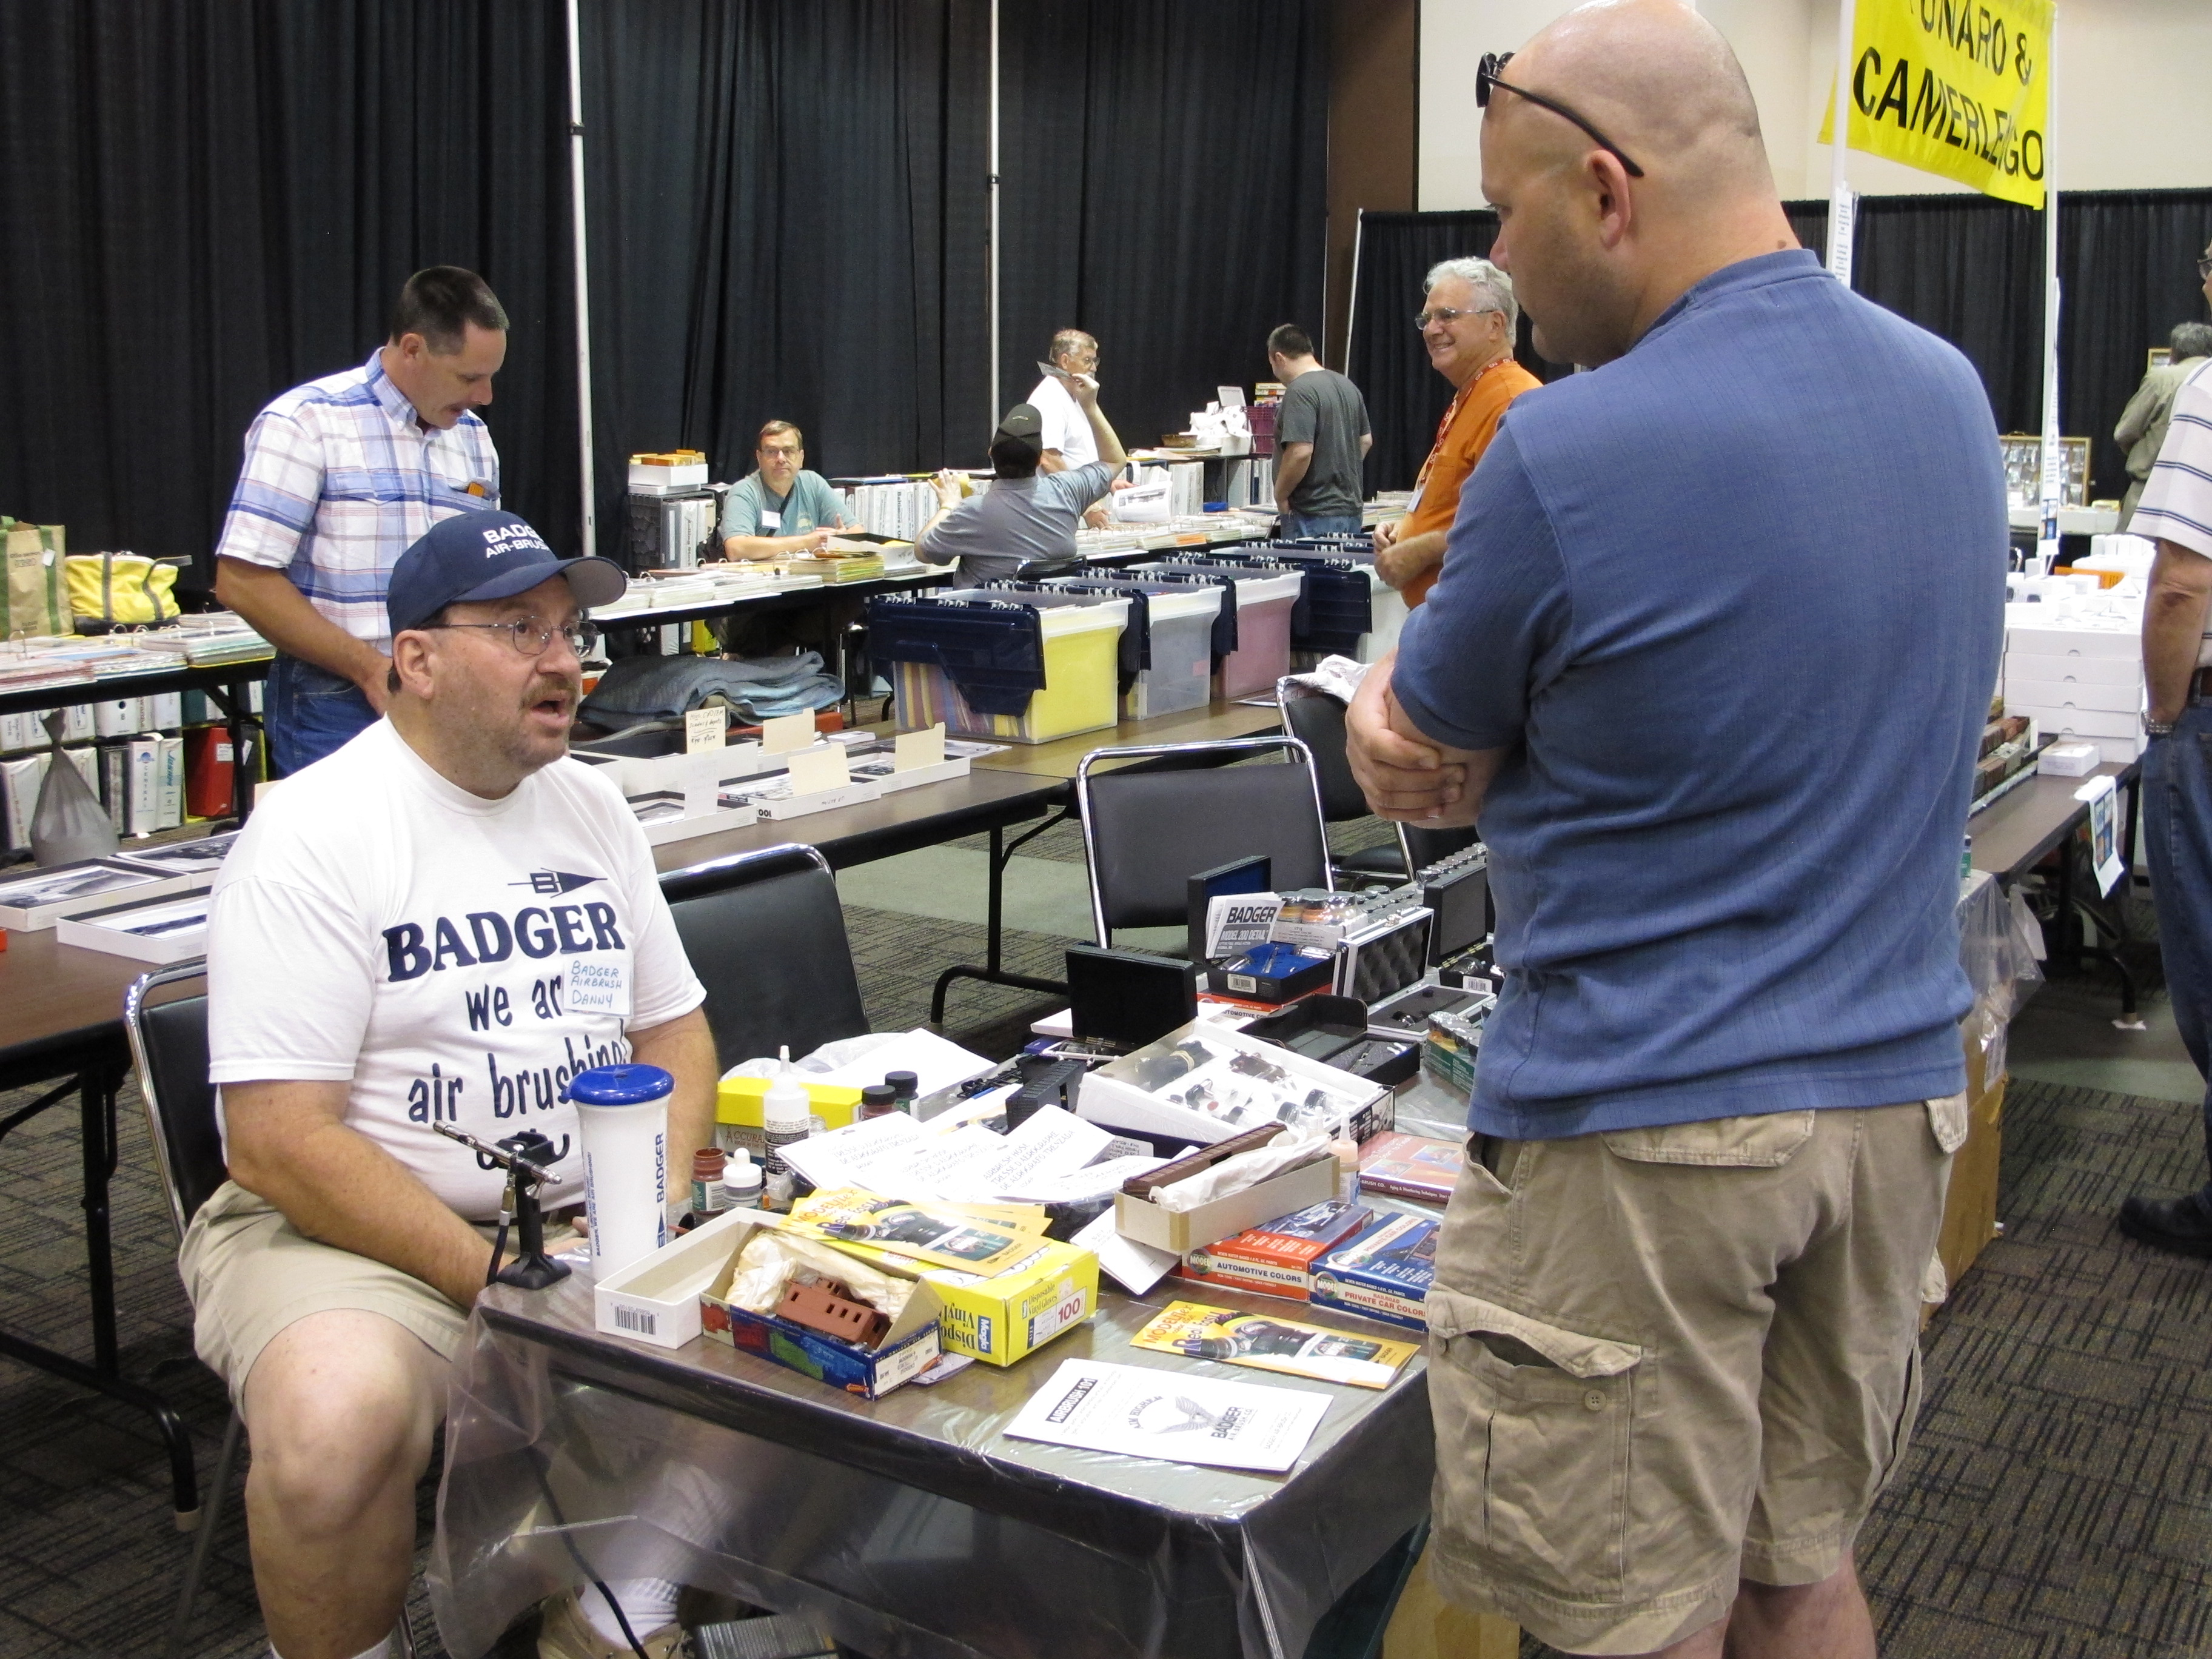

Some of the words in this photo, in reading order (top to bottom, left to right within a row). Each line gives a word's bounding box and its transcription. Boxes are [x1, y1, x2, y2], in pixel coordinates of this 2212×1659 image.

[2016, 33, 2032, 86] &
[486, 540, 549, 559] AIR-BRUS
[1227, 907, 1278, 923] BADGER
[382, 902, 626, 983] BADGER
[571, 960, 620, 978] BADGER
[571, 975, 622, 990] AIRBRUSH
[465, 983, 513, 1031] we
[531, 975, 563, 1021] ar
[572, 990, 614, 1009] DANNY
[407, 1063, 464, 1124] air
[725, 1127, 765, 1144] ACCURA
[655, 1132, 665, 1204] BADGER
[1190, 1255, 1210, 1266] MODEL
[1217, 1262, 1268, 1276] AUTOMOTIVE
[1270, 1272, 1302, 1282] COLORS
[1029, 1283, 1055, 1302] Disposable
[1317, 1279, 1337, 1292] MODEL
[1028, 1303, 1041, 1315] Vinyl
[1042, 1295, 1057, 1312] Gloves
[1345, 1292, 1376, 1304] PRIVATE
[1378, 1299, 1395, 1309] CAR
[1373, 1293, 1399, 1304] RAILROAD
[944, 1303, 975, 1329] Vinyl
[1059, 1298, 1081, 1322] 100
[940, 1324, 976, 1350] Dispo
[980, 1318, 990, 1352] Magla
[1050, 1389, 1087, 1423] AIRBRUSH
[1078, 1378, 1096, 1389] 101
[1210, 1406, 1241, 1439] BADGER
